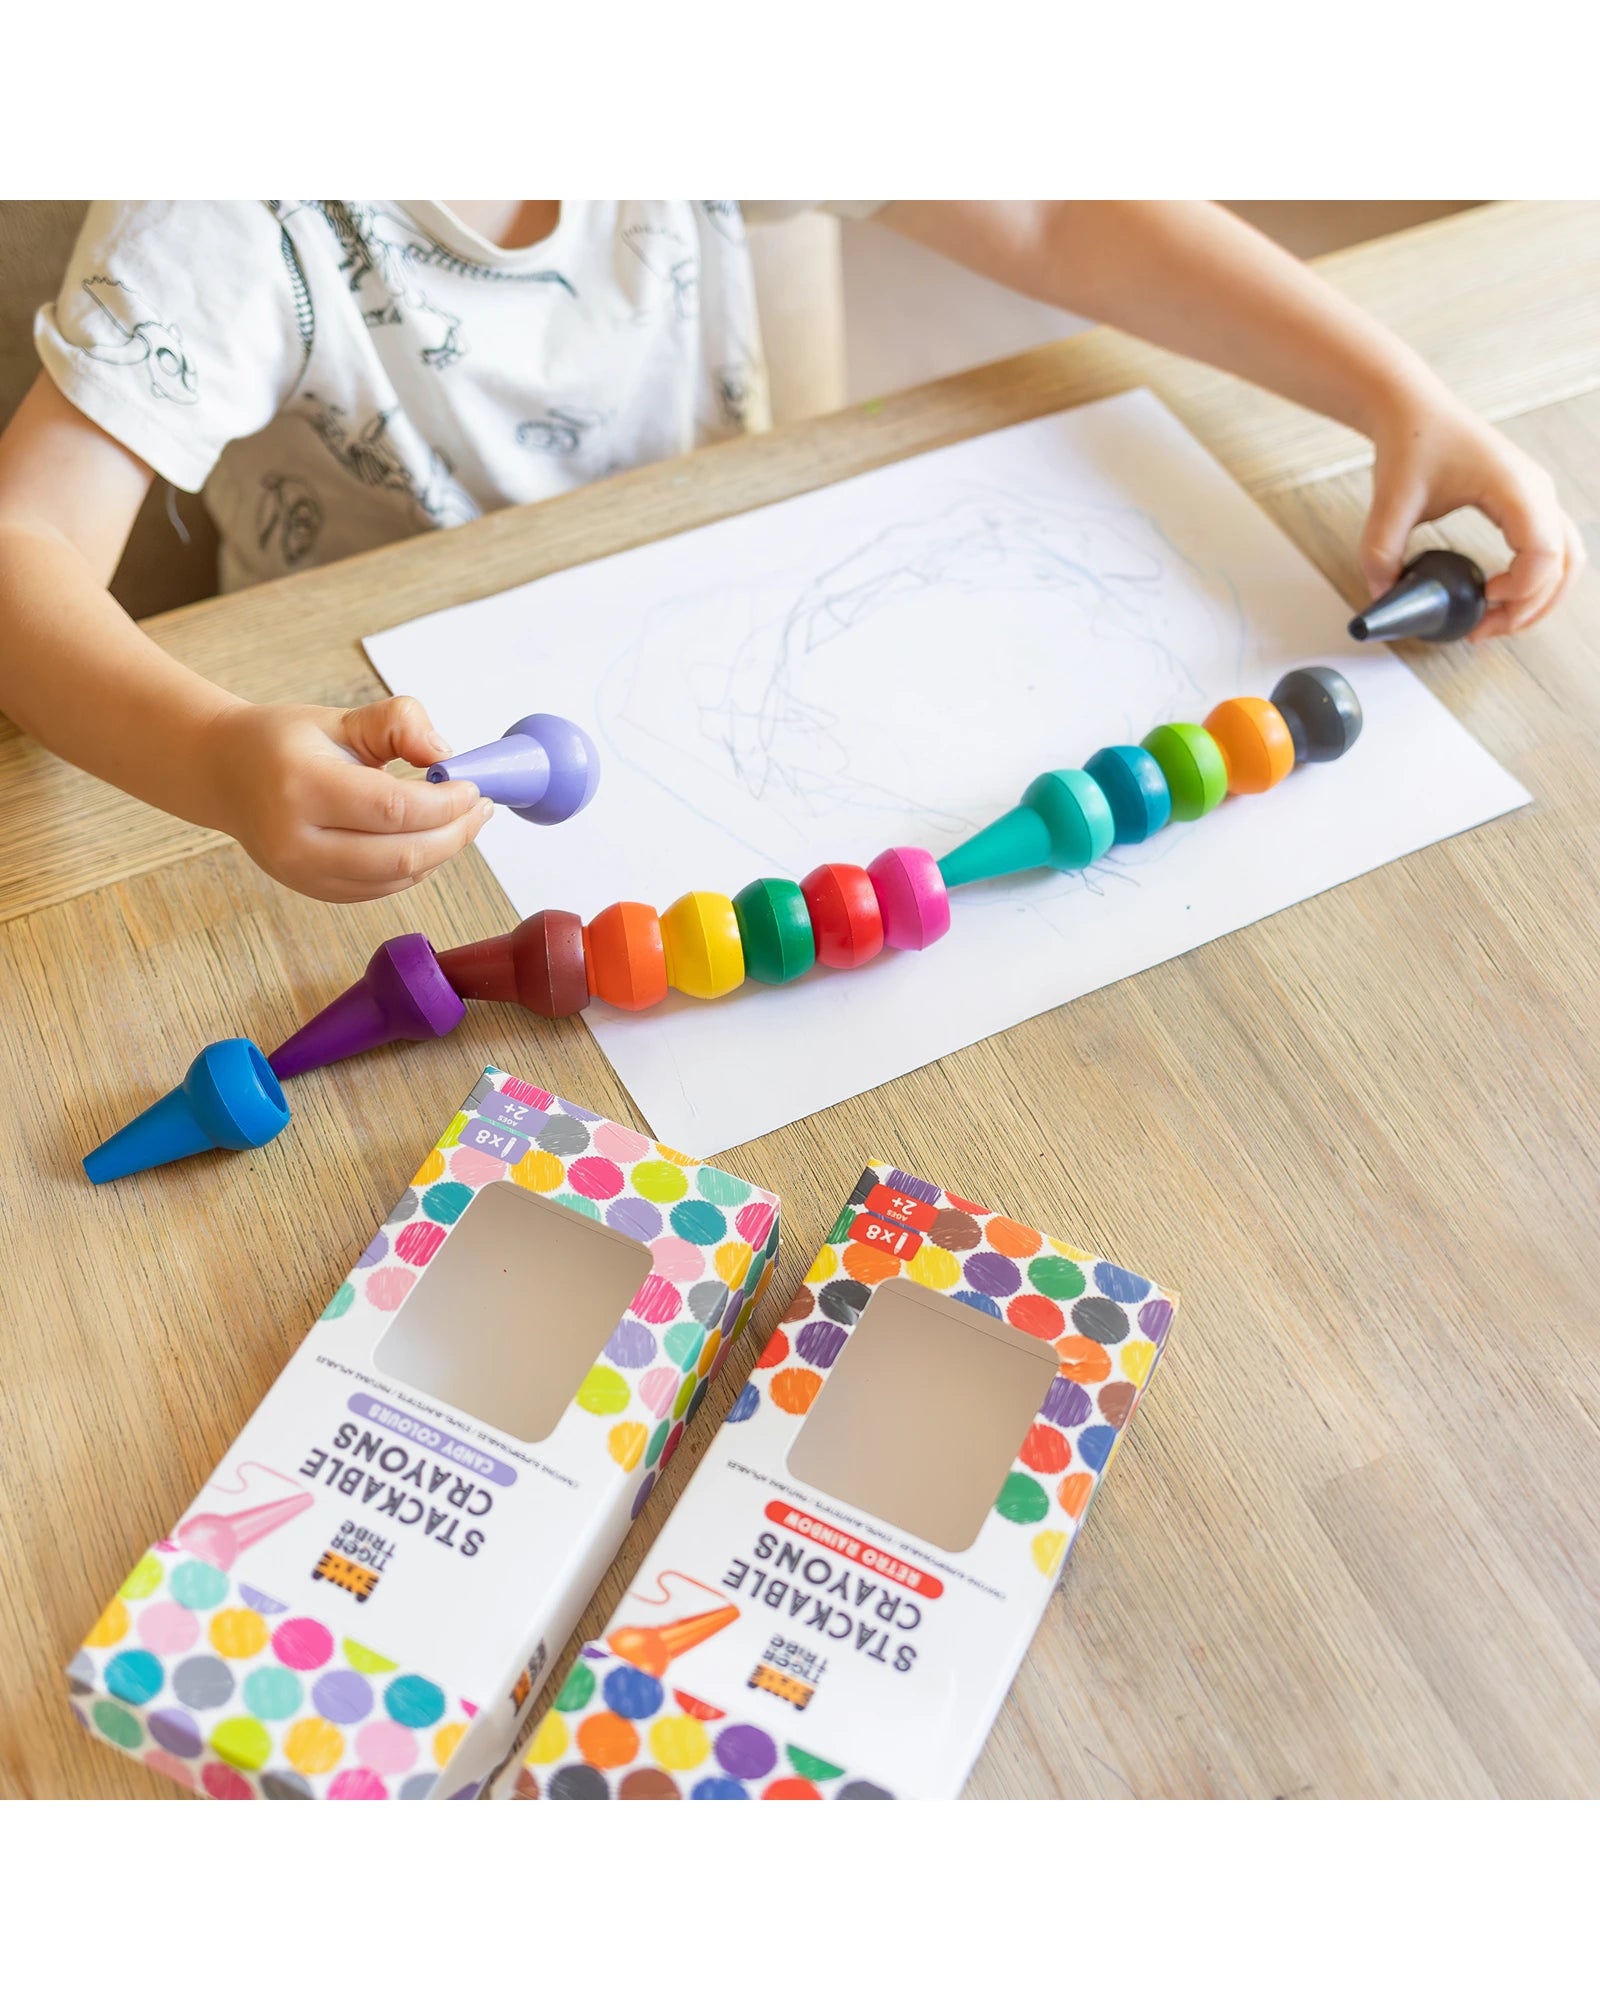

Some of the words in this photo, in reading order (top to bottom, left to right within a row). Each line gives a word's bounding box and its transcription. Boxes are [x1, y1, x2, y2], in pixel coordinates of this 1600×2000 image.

[497, 1115, 519, 1127] AGES
[504, 1103, 529, 1120] 2+
[886, 1209, 909, 1222] AGES
[891, 1197, 917, 1215] 2+
[368, 1403, 442, 1447] COLOURS
[333, 1422, 493, 1516] CRAYONS
[441, 1441, 495, 1475] CANDY
[299, 1448, 486, 1556] STACKABLE
[783, 1510, 861, 1554] RAINBOW
[754, 1531, 921, 1630] CRAYONS
[862, 1548, 921, 1587] RETRO
[722, 1558, 917, 1672] STACKABLE
